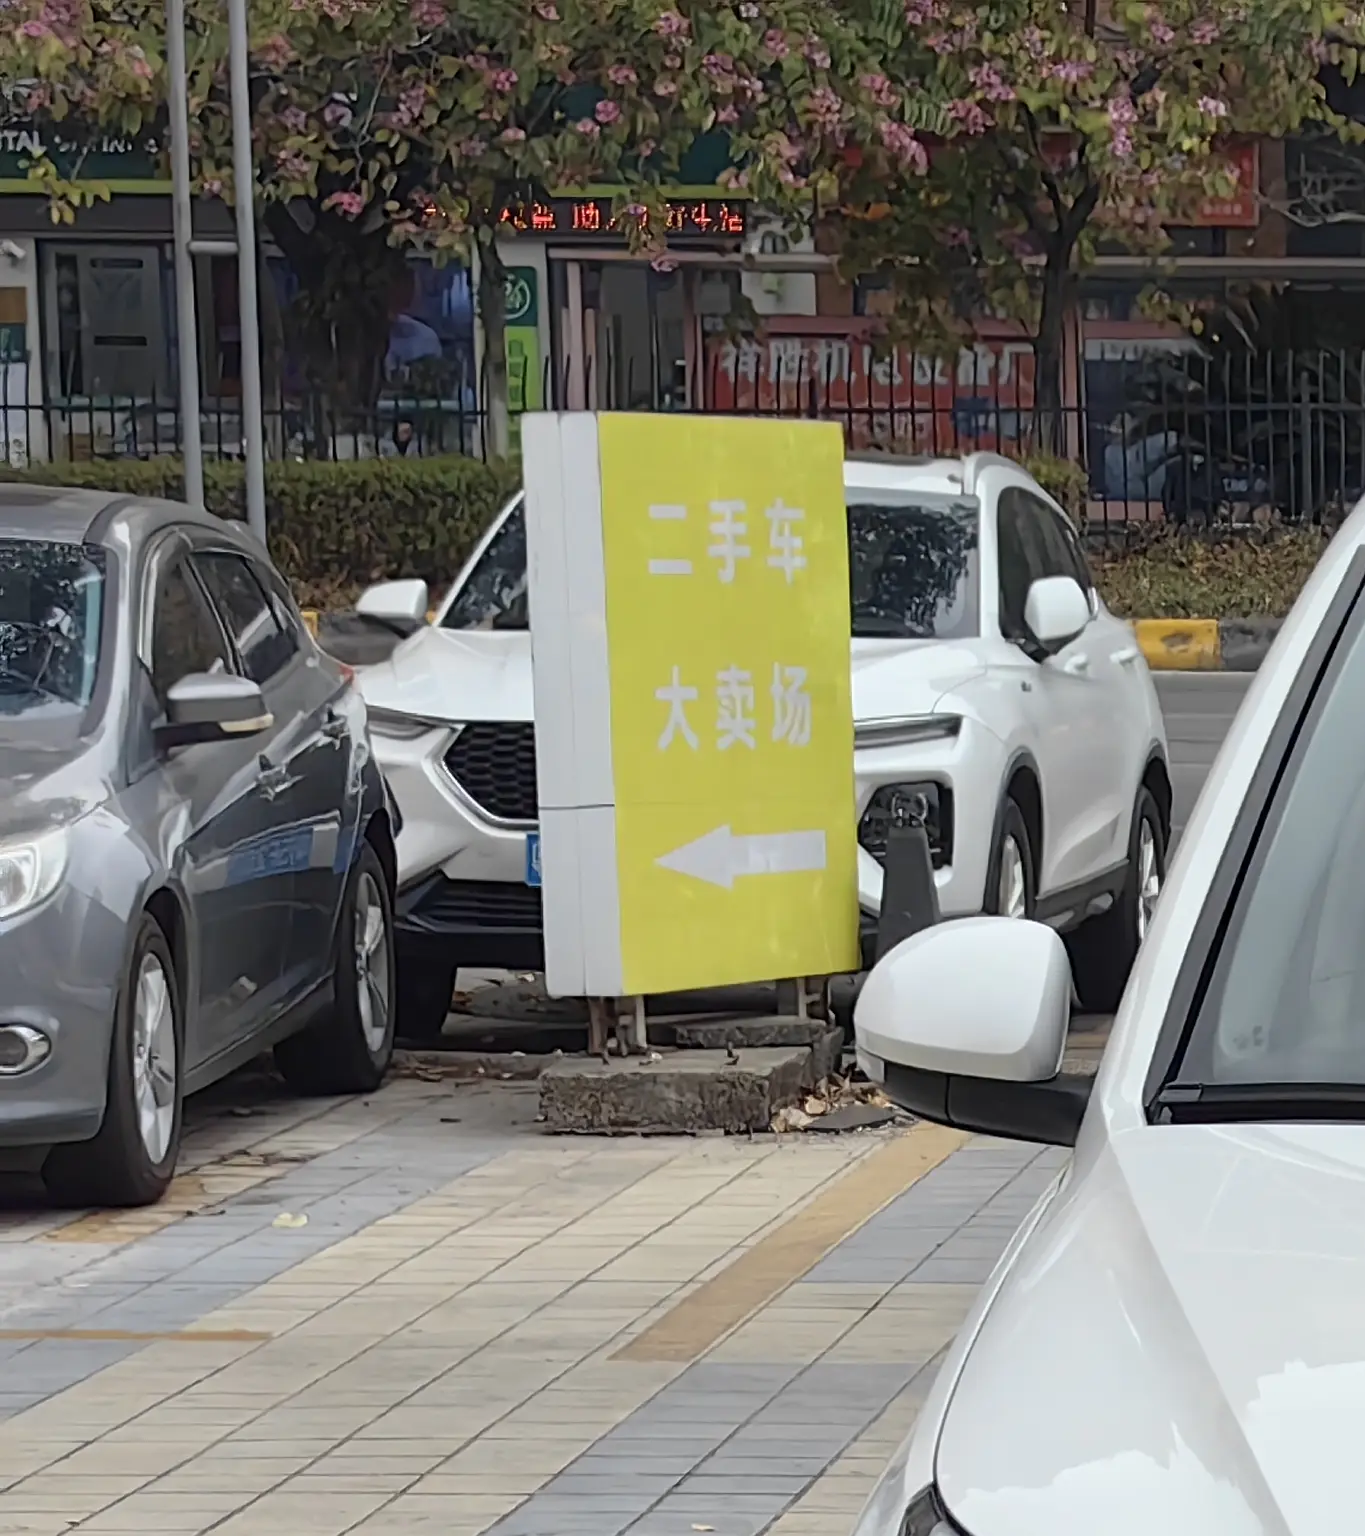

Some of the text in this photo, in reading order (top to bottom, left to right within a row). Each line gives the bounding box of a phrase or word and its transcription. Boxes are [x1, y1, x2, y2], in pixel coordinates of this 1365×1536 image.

[648, 497, 807, 585] 二手车
[654, 662, 812, 751] 大卖场
